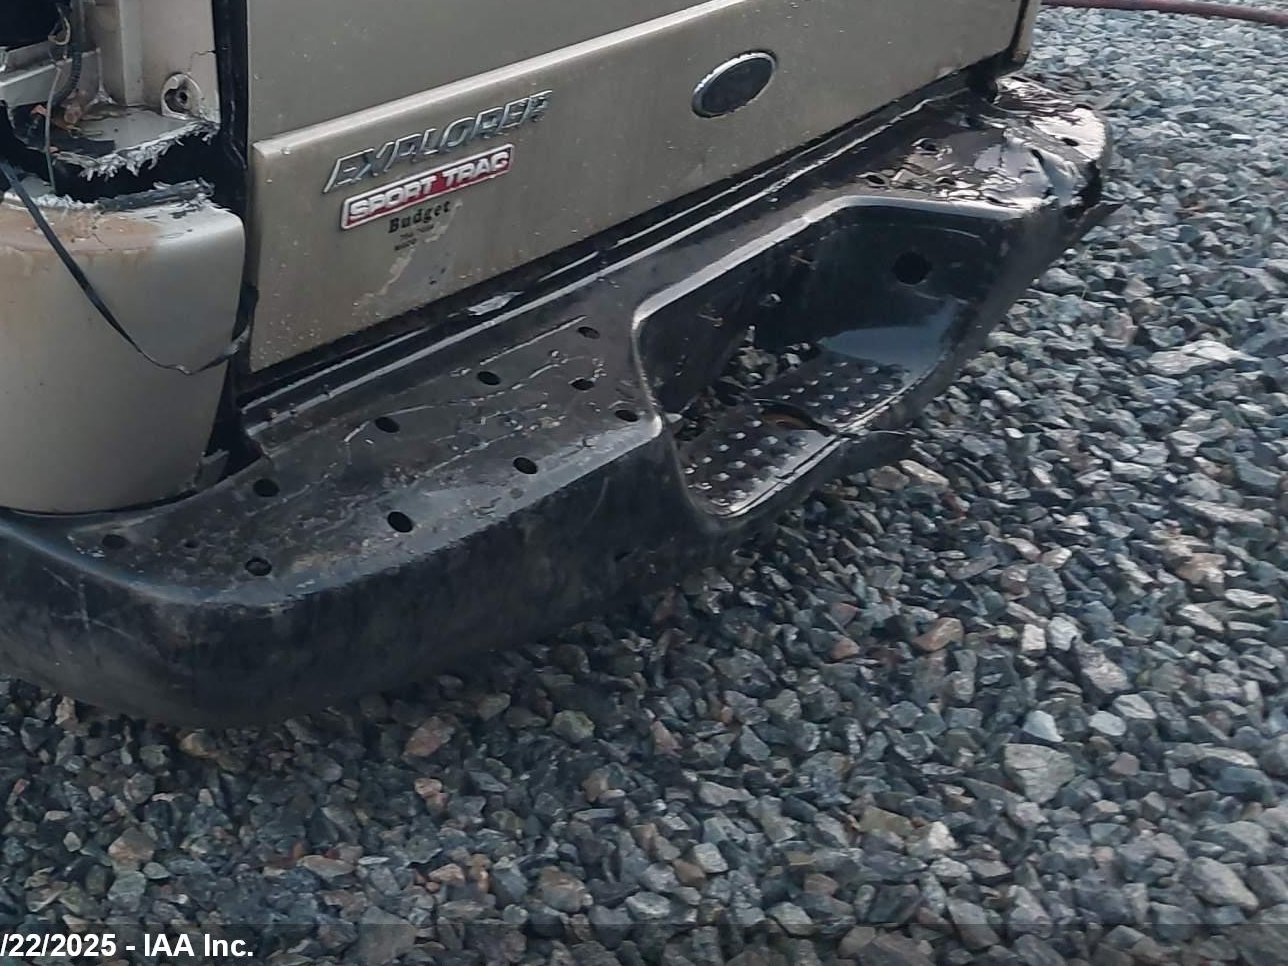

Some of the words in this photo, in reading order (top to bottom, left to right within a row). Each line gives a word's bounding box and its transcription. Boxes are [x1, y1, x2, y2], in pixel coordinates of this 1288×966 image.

[323, 90, 553, 193] EXPLORER
[349, 176, 437, 220] SPORT
[442, 151, 510, 186] TRAC
[388, 200, 451, 233] Budget
